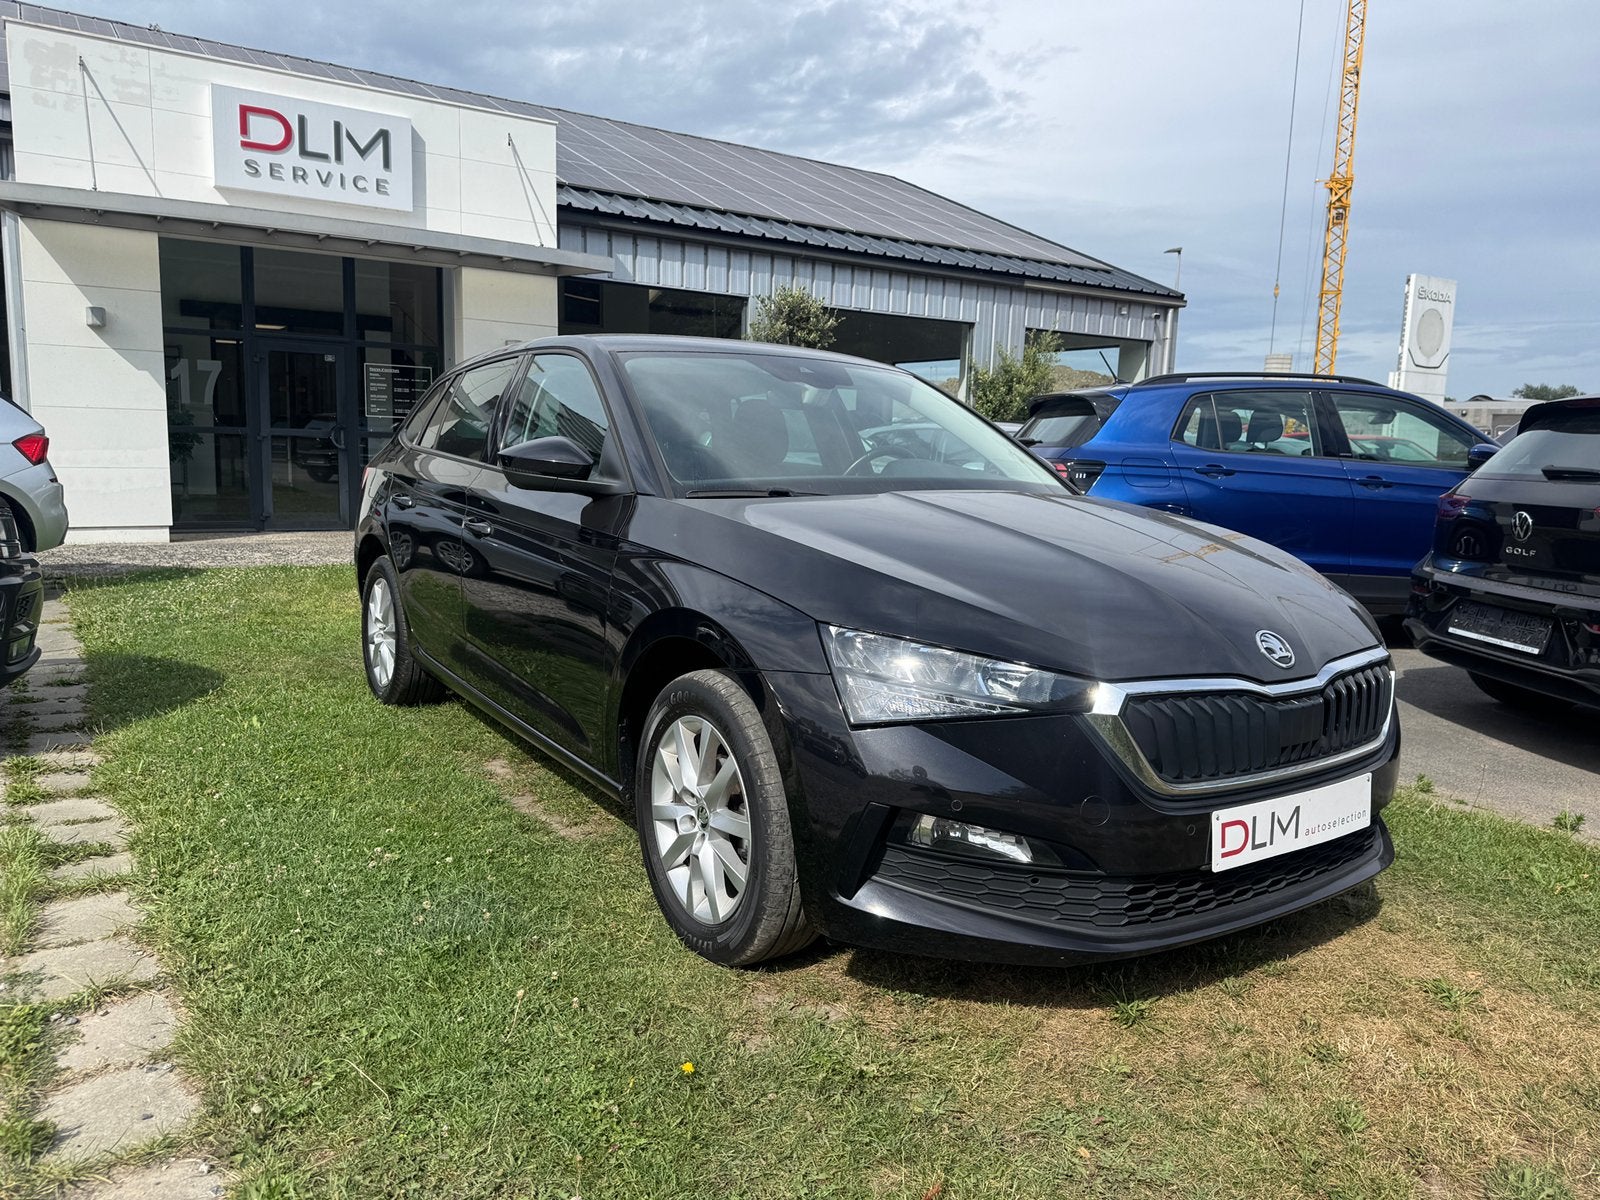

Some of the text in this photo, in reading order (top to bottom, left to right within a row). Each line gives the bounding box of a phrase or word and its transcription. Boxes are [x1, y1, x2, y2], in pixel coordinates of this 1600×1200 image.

[239, 104, 390, 170] DLM
[244, 159, 390, 196] SERVICE
[170, 358, 222, 405] 17
[1505, 546, 1536, 557] GOLF
[1221, 805, 1367, 859] DLM autoselection
